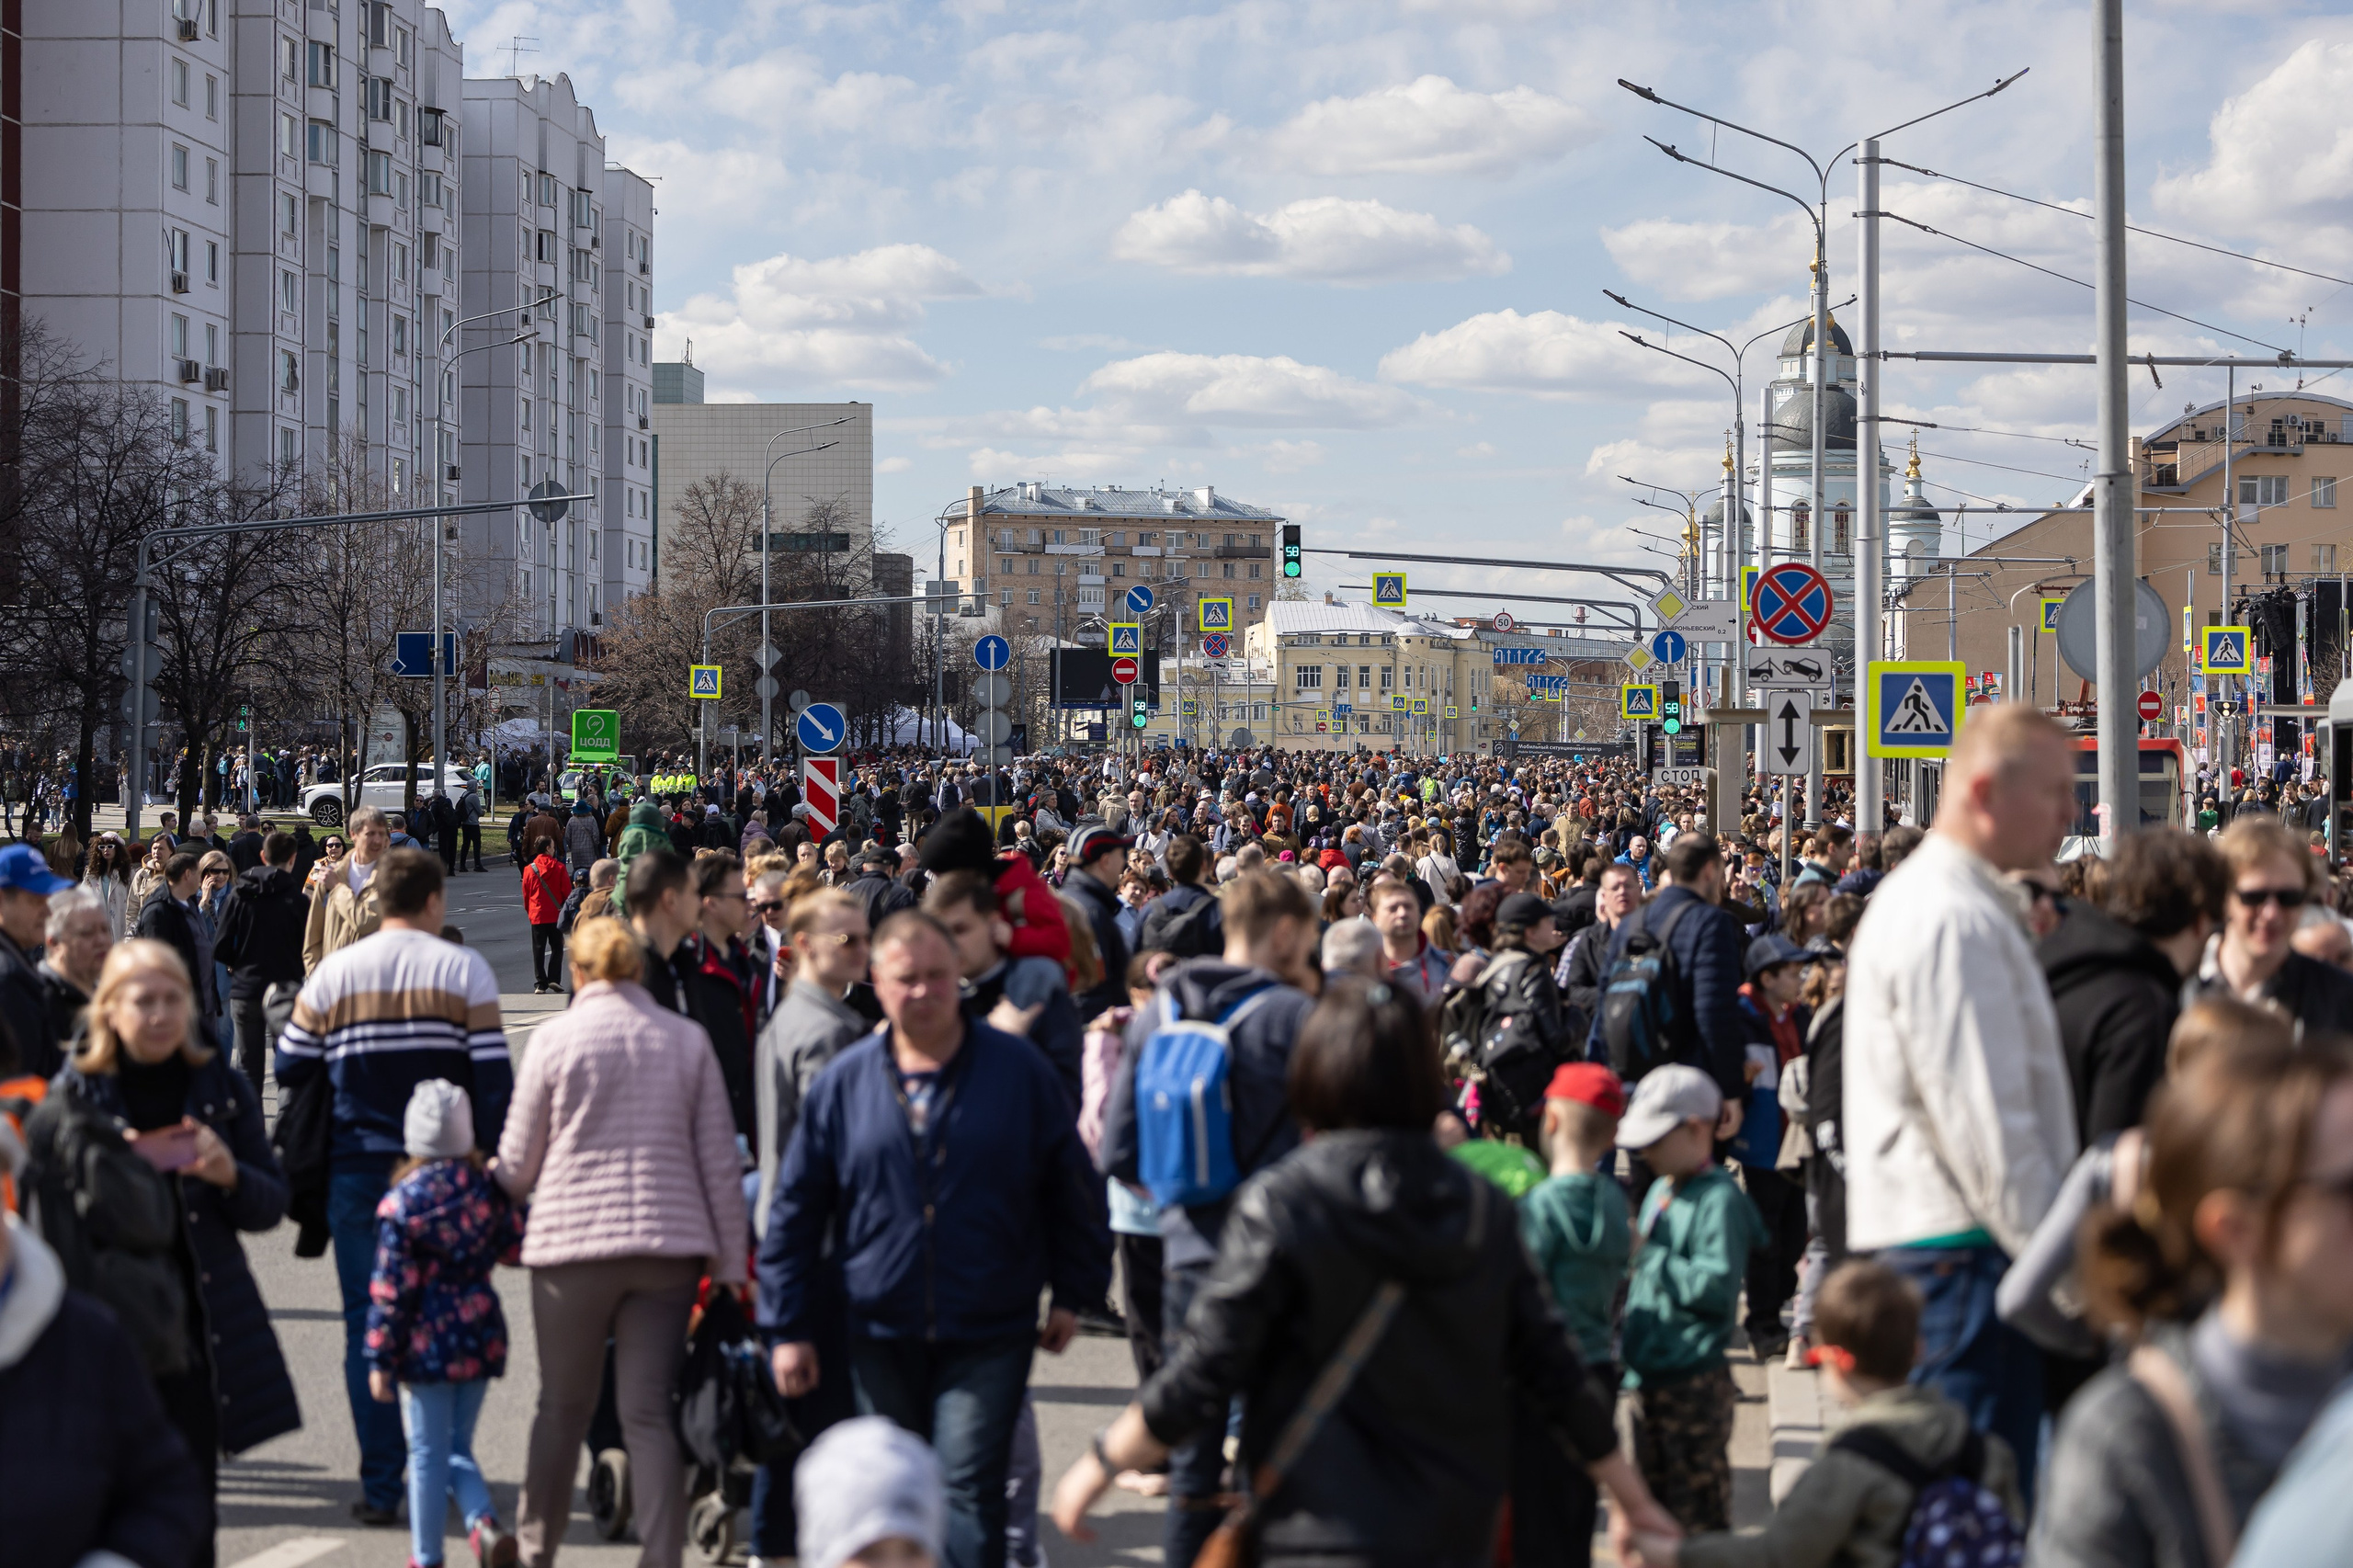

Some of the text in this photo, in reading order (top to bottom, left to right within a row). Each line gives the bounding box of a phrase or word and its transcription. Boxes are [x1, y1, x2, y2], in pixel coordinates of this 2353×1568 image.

[1286, 546, 1299, 557] 58
[1497, 619, 1509, 627] 50
[1134, 701, 1146, 711] 58
[1665, 702, 1678, 714] 58
[580, 737, 610, 748] ЦОДД
[1661, 769, 1699, 782] СТОП
